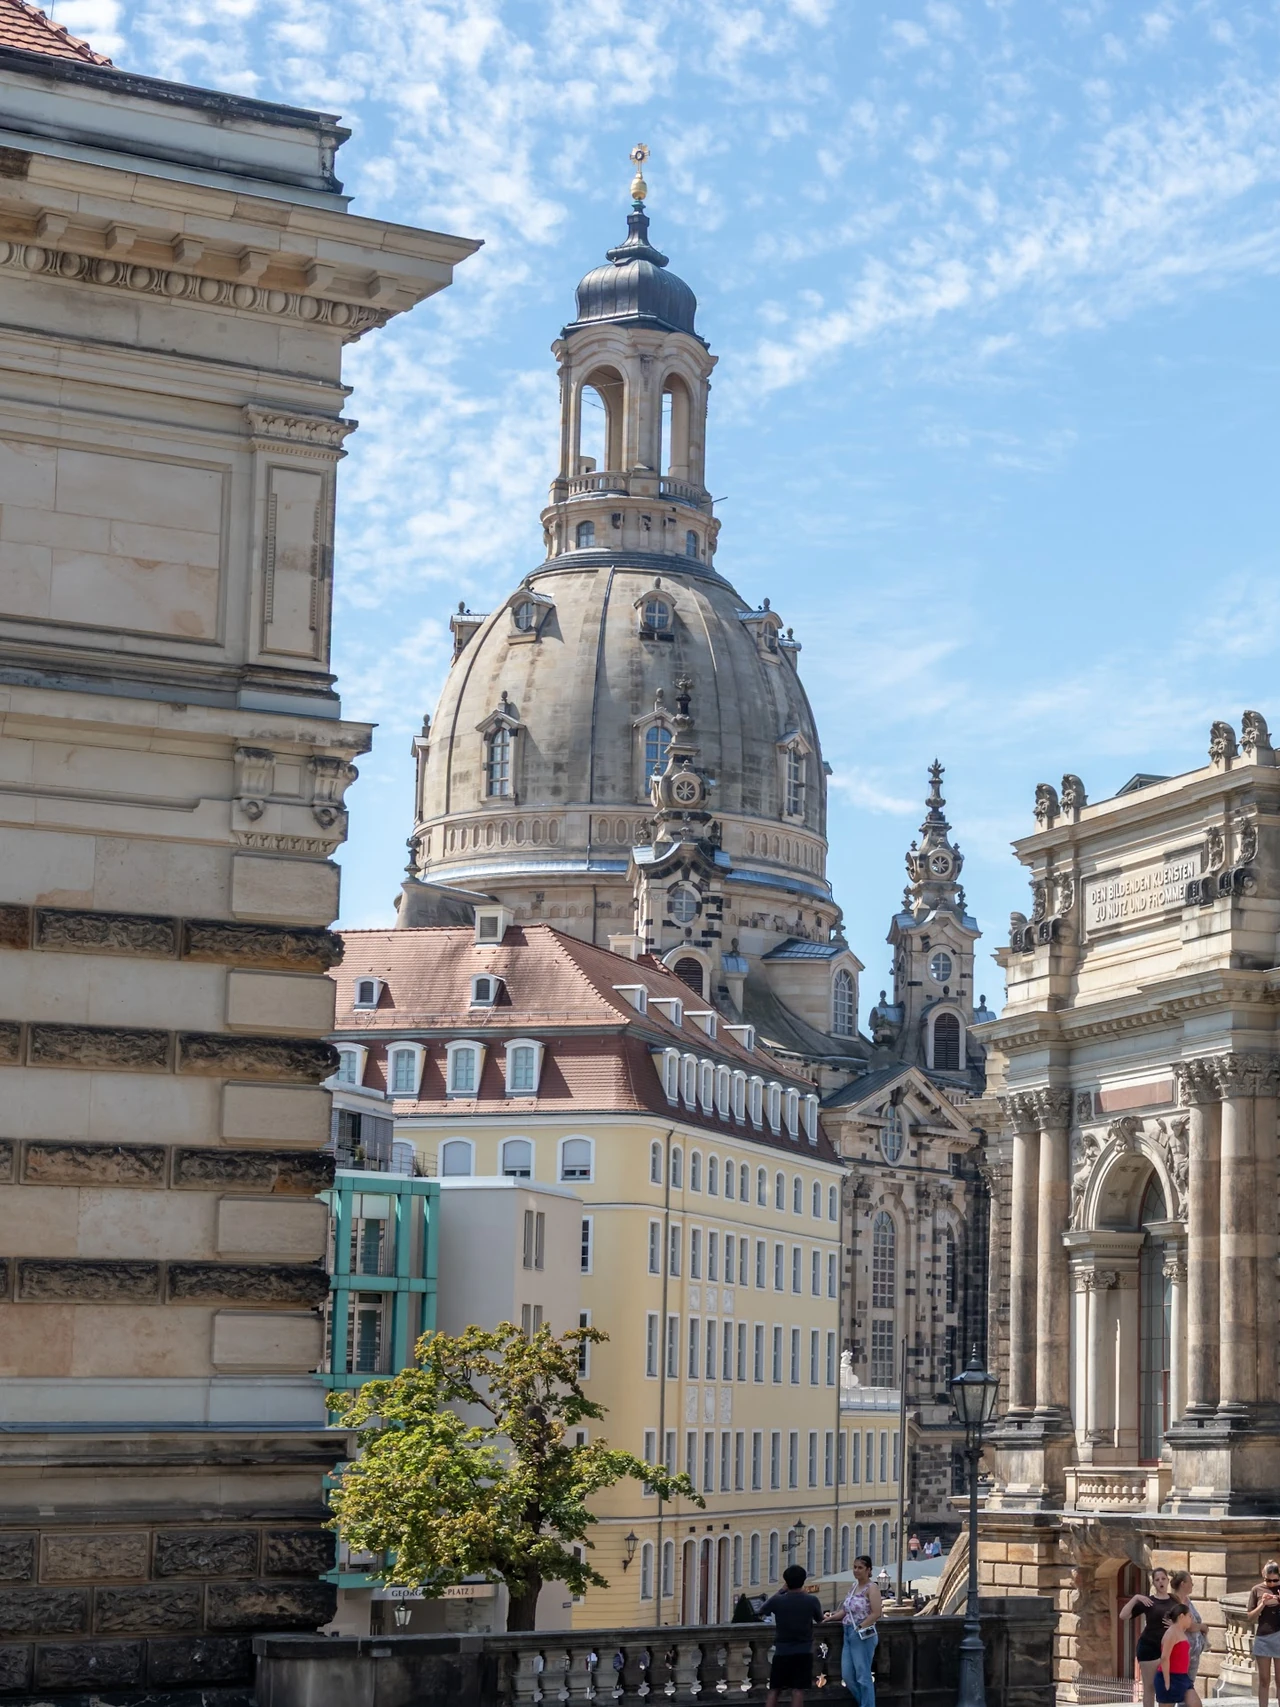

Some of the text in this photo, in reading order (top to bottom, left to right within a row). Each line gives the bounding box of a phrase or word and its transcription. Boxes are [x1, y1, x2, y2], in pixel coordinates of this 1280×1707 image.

[1091, 861, 1195, 905] DEN BILDENDEN KUENSTEN
[1095, 905, 1107, 923] ZU
[1108, 899, 1128, 920] NUTZ
[1130, 896, 1147, 914] UND
